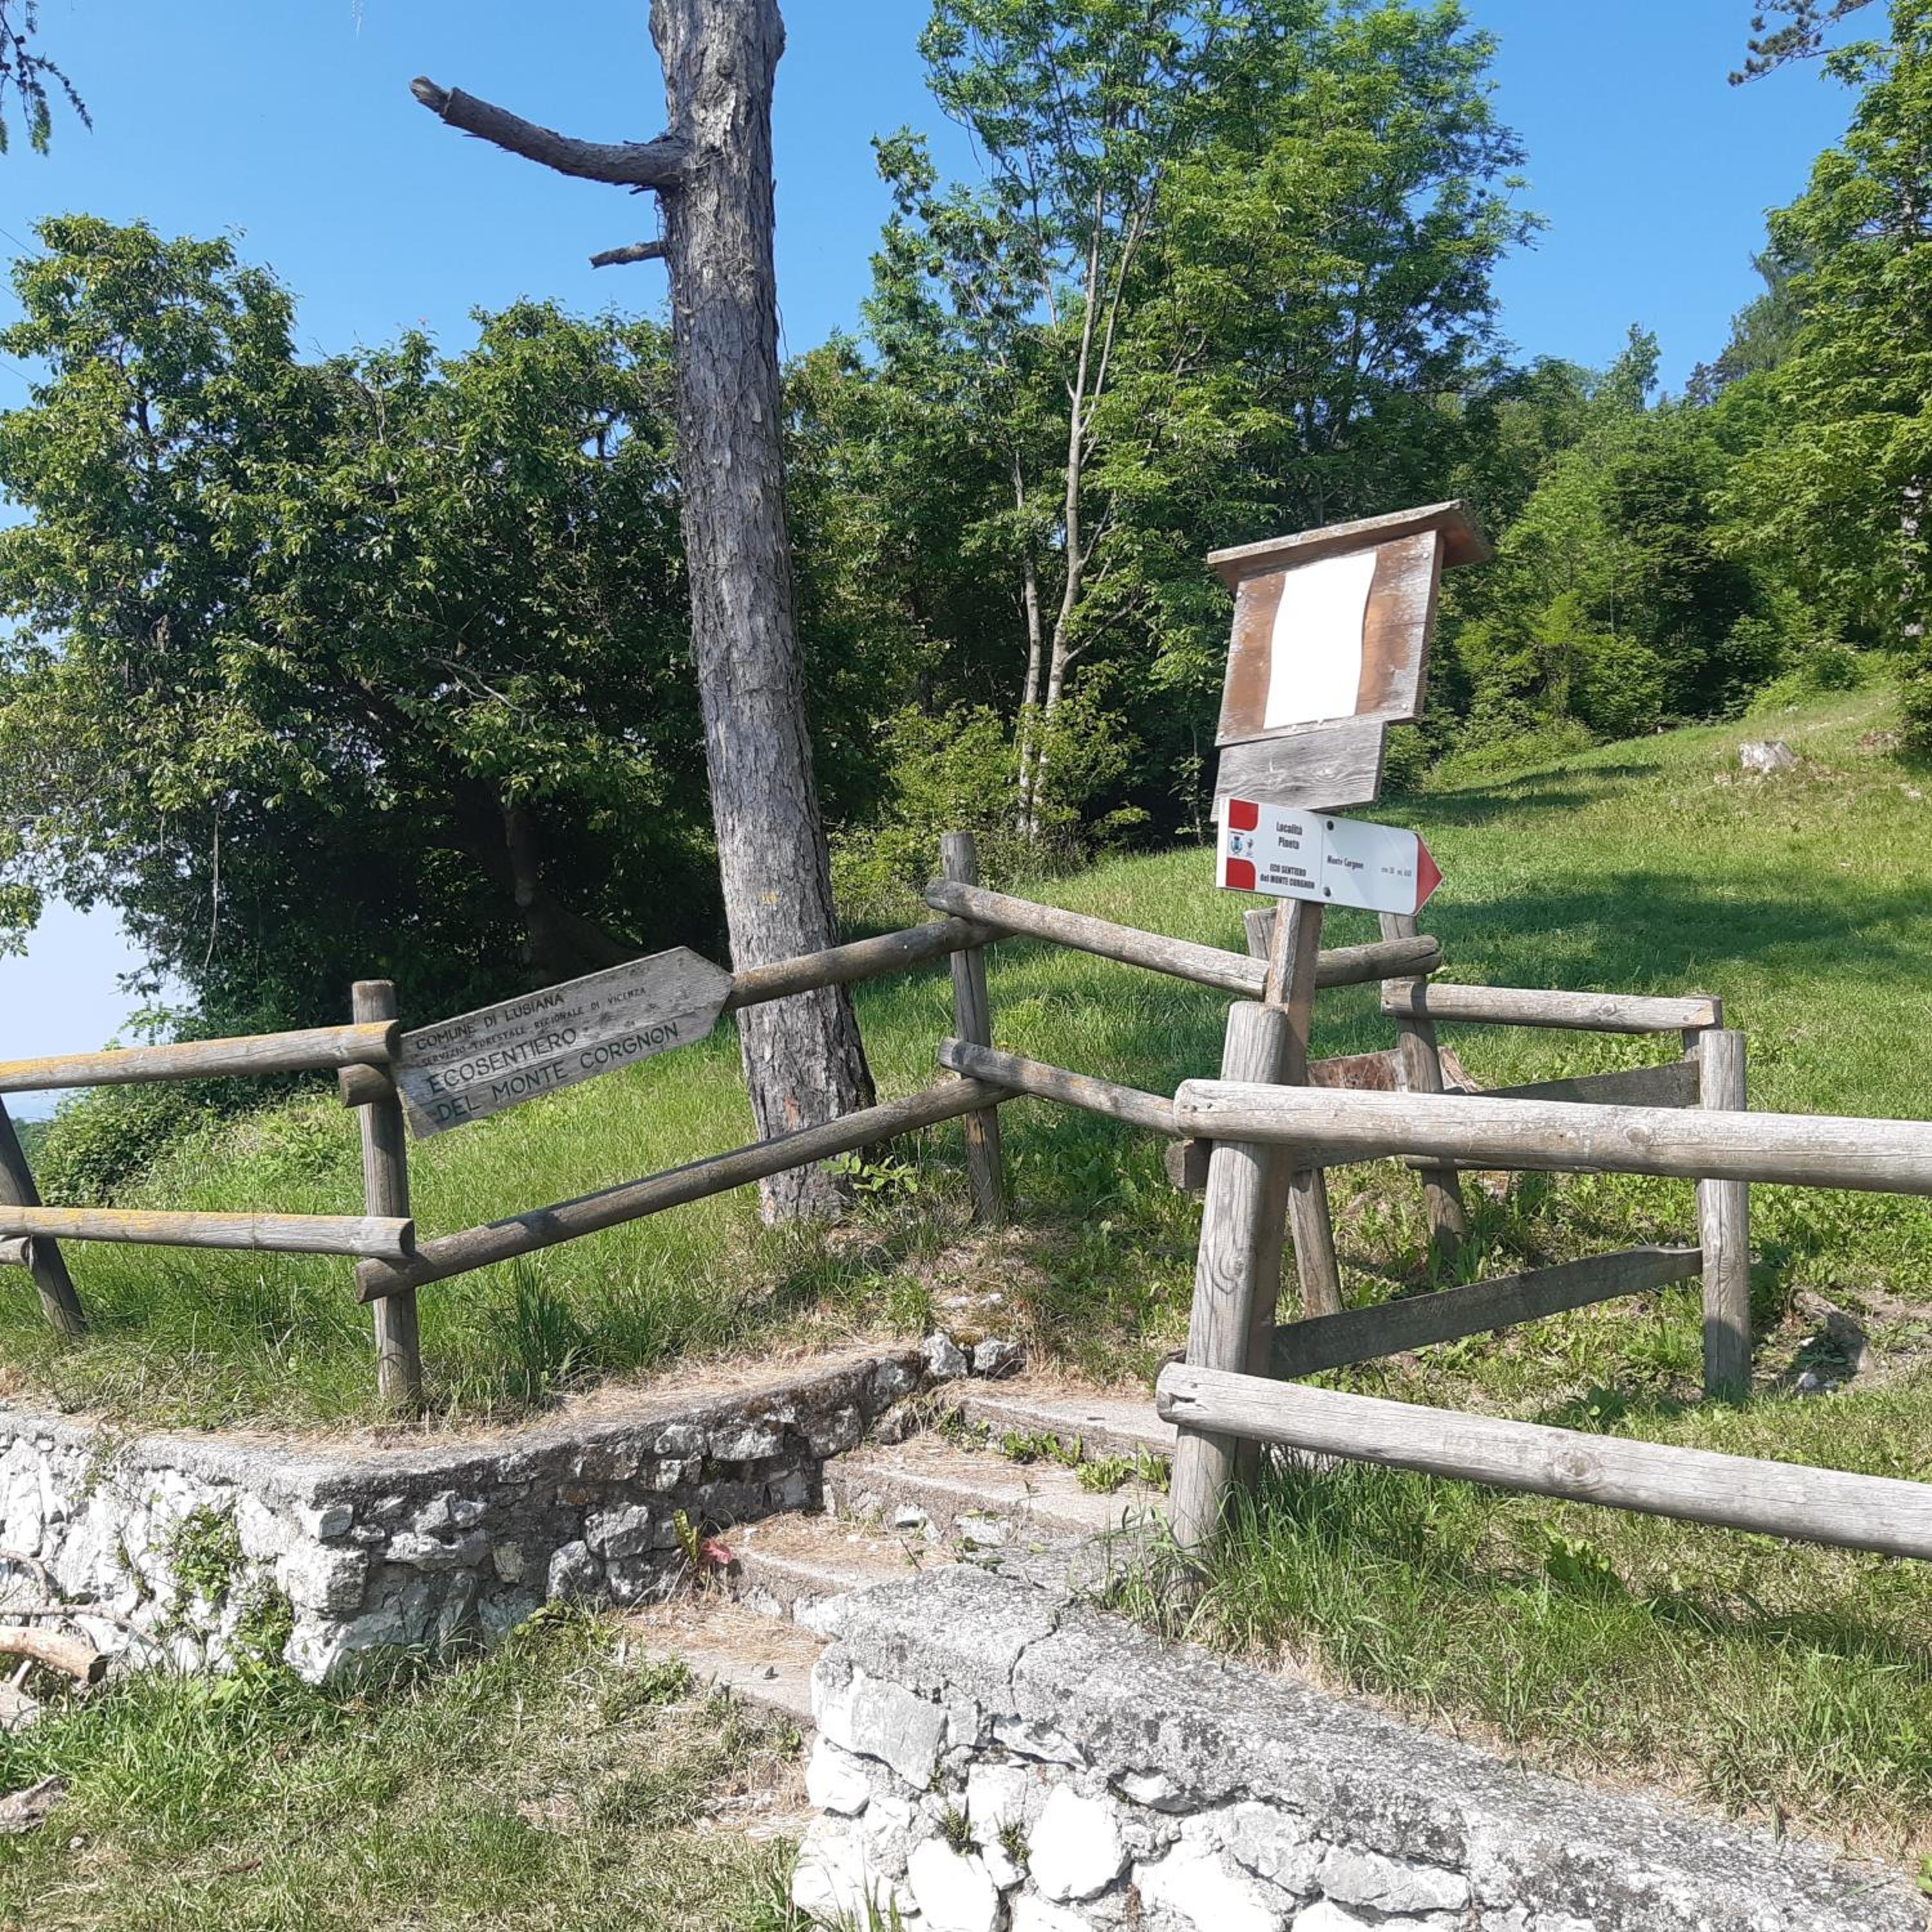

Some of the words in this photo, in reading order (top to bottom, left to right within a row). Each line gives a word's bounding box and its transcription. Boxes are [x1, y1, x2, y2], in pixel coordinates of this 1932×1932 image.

[1270, 875, 1288, 886] MONTE
[1289, 878, 1315, 889] CORGNON
[1282, 865, 1306, 876] SENTIERO
[417, 1023, 475, 1050] COMUNE
[484, 1013, 497, 1028] DI
[504, 993, 565, 1022] LUSIANA
[534, 1007, 585, 1029] REGIONALE
[591, 1001, 600, 1010] DI
[607, 987, 646, 1005] VICENZA
[426, 1028, 576, 1094] ECOSENTIERO
[437, 1095, 482, 1122] DEL
[491, 1060, 569, 1101] MONTE
[580, 1021, 679, 1069] CORGNON
